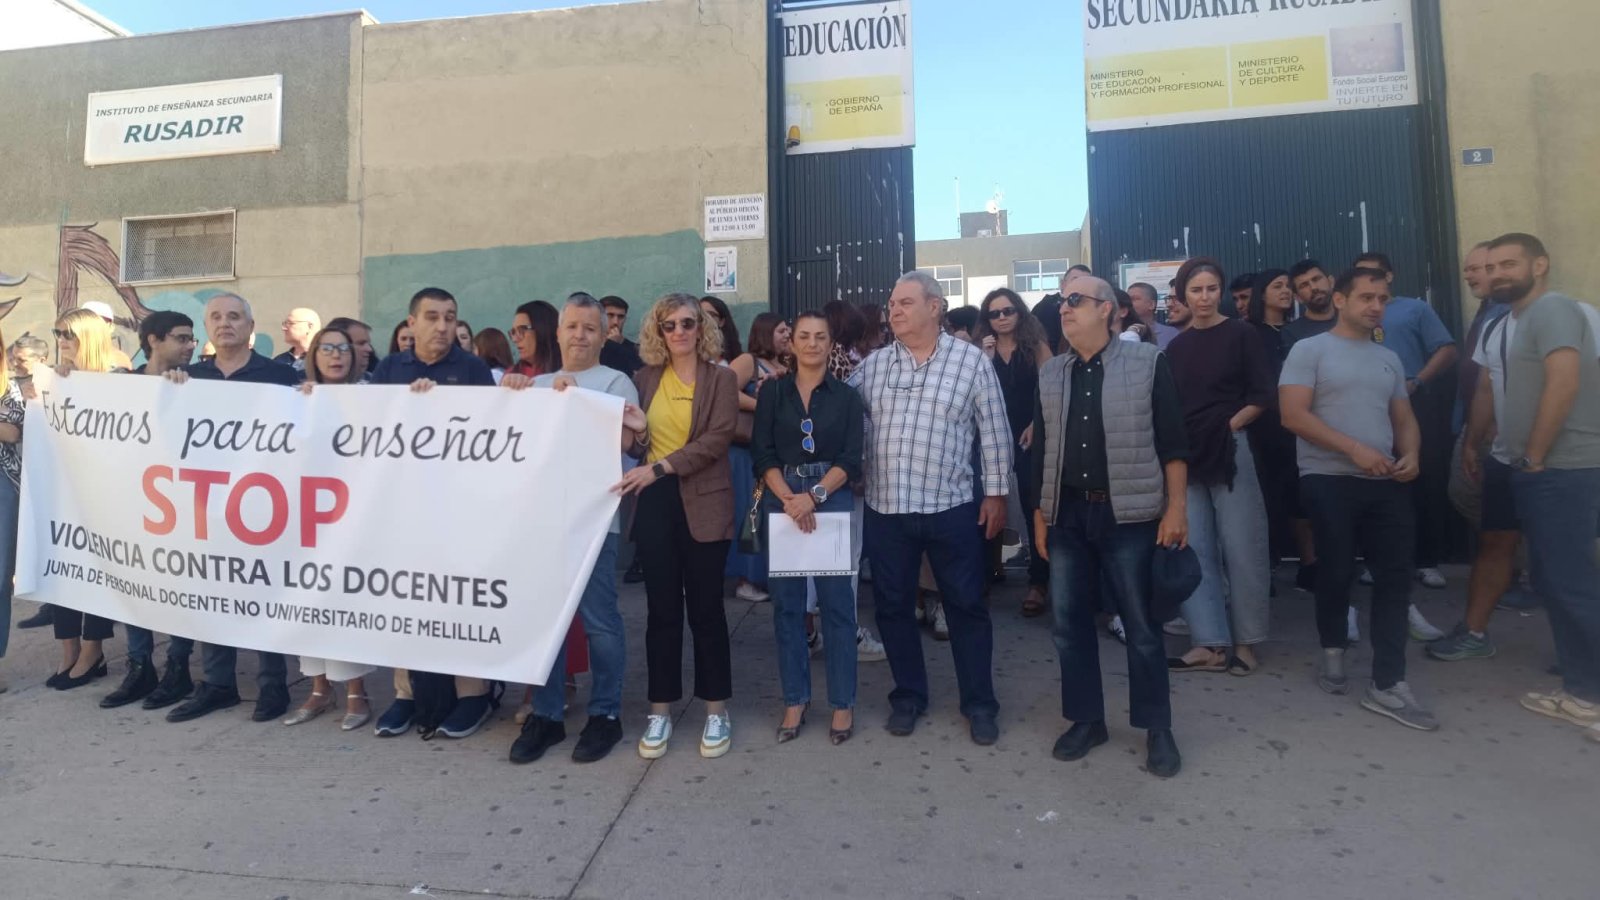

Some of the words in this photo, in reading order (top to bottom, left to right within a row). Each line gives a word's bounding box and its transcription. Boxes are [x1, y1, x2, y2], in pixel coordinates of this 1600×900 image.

[784, 5, 907, 57] EDUCACIÓN
[1238, 55, 1299, 68] MINISTERIO
[1090, 69, 1144, 81] MINISTERIO
[1239, 69, 1252, 77] DE
[1255, 64, 1305, 75] CULTURA
[1106, 75, 1161, 88] EDUCACIÓN
[1249, 73, 1299, 86] DEPORTE
[1100, 85, 1156, 98] FORMACIÓN
[1158, 79, 1225, 93] PROFESIONAL
[1336, 86, 1389, 96] INVIERTE
[1391, 83, 1408, 93] EN
[96, 106, 145, 117] INSTITUTO
[147, 104, 160, 112] DE
[161, 99, 214, 112] ENSEÑANZA
[216, 93, 273, 106] SECUNDARIA
[828, 95, 880, 107] GOBIERNO
[1336, 97, 1352, 105] TU
[829, 107, 843, 115] DE
[844, 103, 883, 114] ESPAÑA
[123, 115, 244, 143] RUSADIR
[1472, 151, 1482, 162] 2
[180, 417, 296, 460] para
[331, 416, 526, 464] enseñar
[142, 464, 350, 549] STOP
[50, 520, 146, 570] VIOLENCIA
[152, 547, 271, 587] CONTRA
[283, 560, 333, 593] LOS
[343, 566, 508, 610] DOCENTES
[44, 558, 84, 582] JUNTA
[87, 567, 103, 585] DE
[105, 572, 157, 602] PERSONAL
[160, 587, 229, 615] DOCENTE
[234, 600, 260, 617] NO
[266, 601, 387, 632] UNIVERSITARIO
[391, 616, 413, 634] DE
[417, 619, 502, 645] MELILLLA
